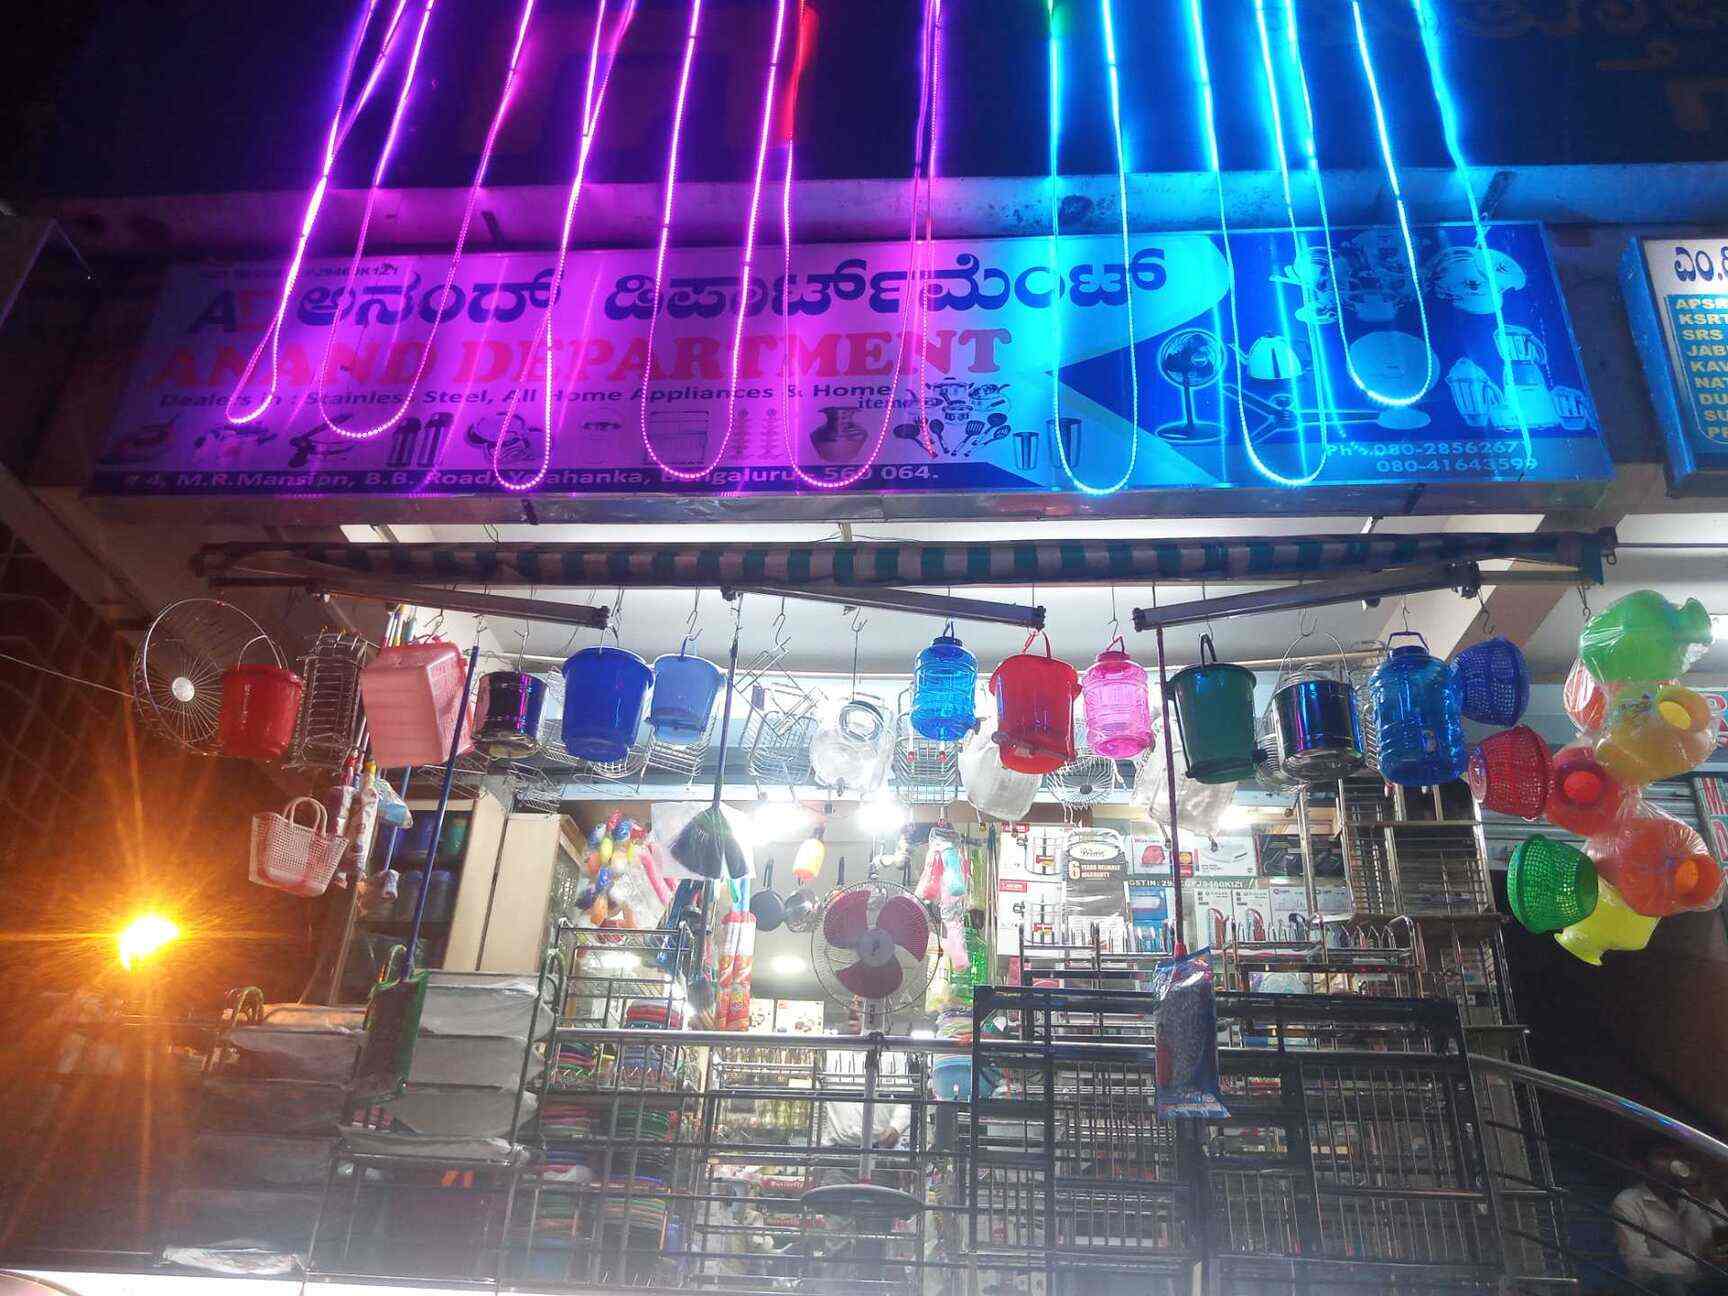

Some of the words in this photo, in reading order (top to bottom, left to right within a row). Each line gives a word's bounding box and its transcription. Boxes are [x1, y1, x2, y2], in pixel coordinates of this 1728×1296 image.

[1682, 329, 1722, 341] SRS
[147, 340, 437, 388] ANAND
[453, 327, 1013, 385] DEPARTMENT
[1687, 344, 1728, 356] JAB
[305, 390, 412, 405] Stainles
[423, 389, 494, 404] Steel,
[502, 388, 537, 403] All
[630, 385, 774, 403] Appliances
[813, 383, 892, 397] Home
[507, 469, 651, 487] Yeahanka,
[661, 467, 796, 485] Bgaluru
